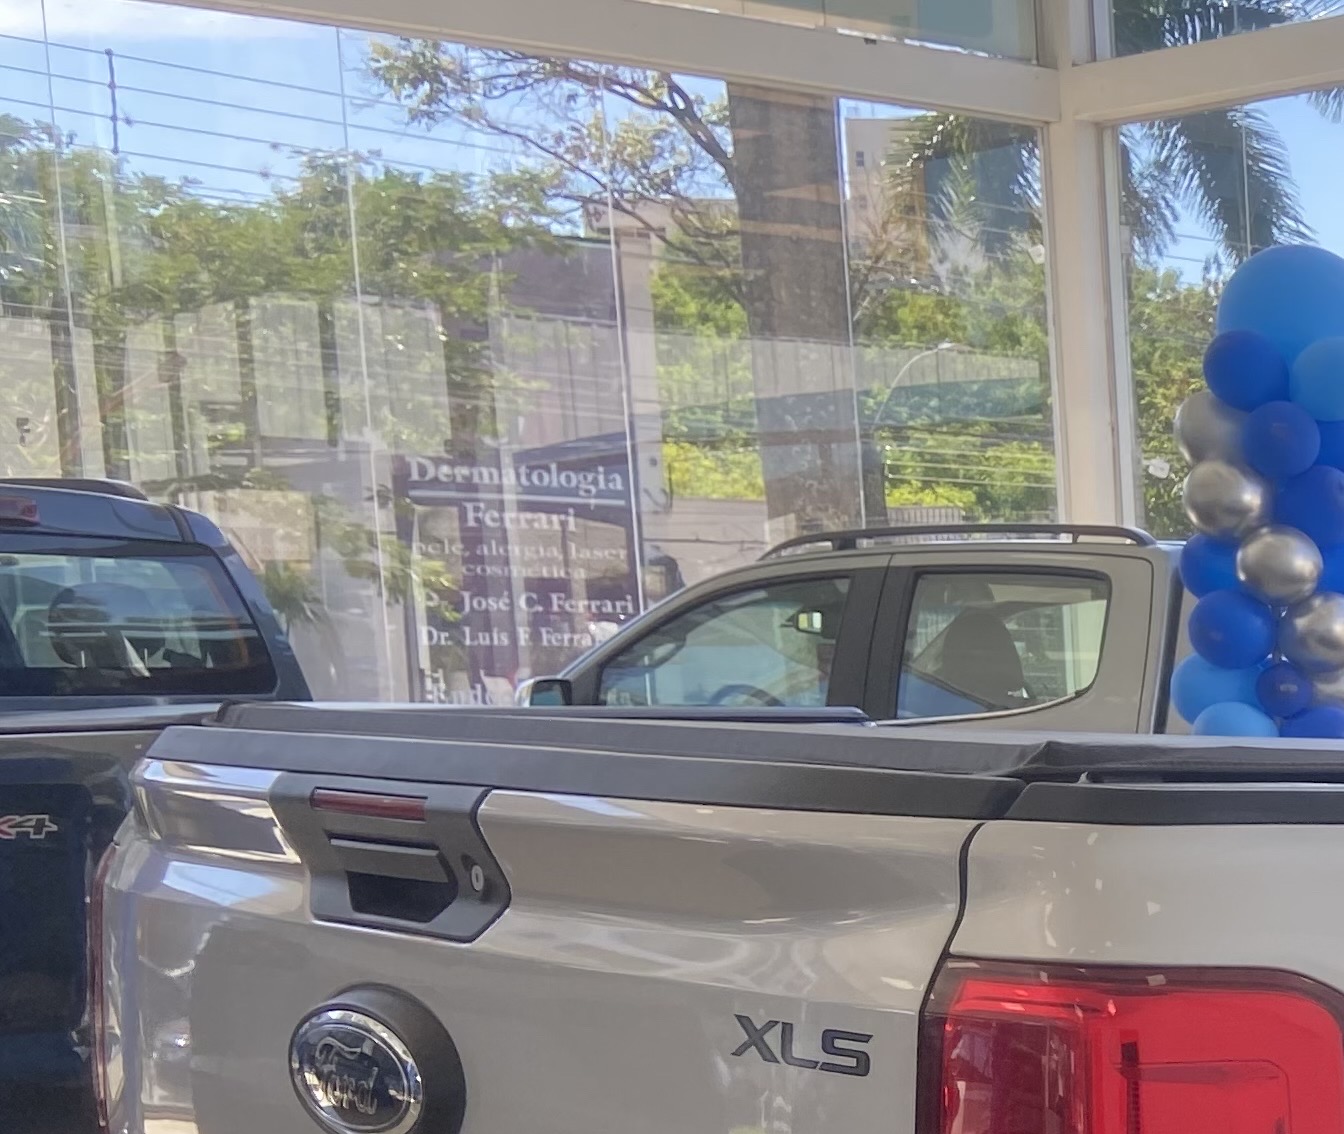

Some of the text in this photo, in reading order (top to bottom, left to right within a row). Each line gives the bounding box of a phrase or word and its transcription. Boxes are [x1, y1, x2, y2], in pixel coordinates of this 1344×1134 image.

[405, 456, 624, 496] Dermatologia
[462, 501, 578, 532] Ferrari
[567, 541, 628, 561] laser
[461, 590, 511, 615] José
[519, 592, 543, 612] C.
[549, 592, 634, 614] Ferrari
[420, 626, 453, 646] Dr.
[463, 625, 508, 646] Luis
[540, 626, 602, 647] Ferra
[730, 1013, 874, 1077] XLS
[314, 1036, 379, 1115] Ford
